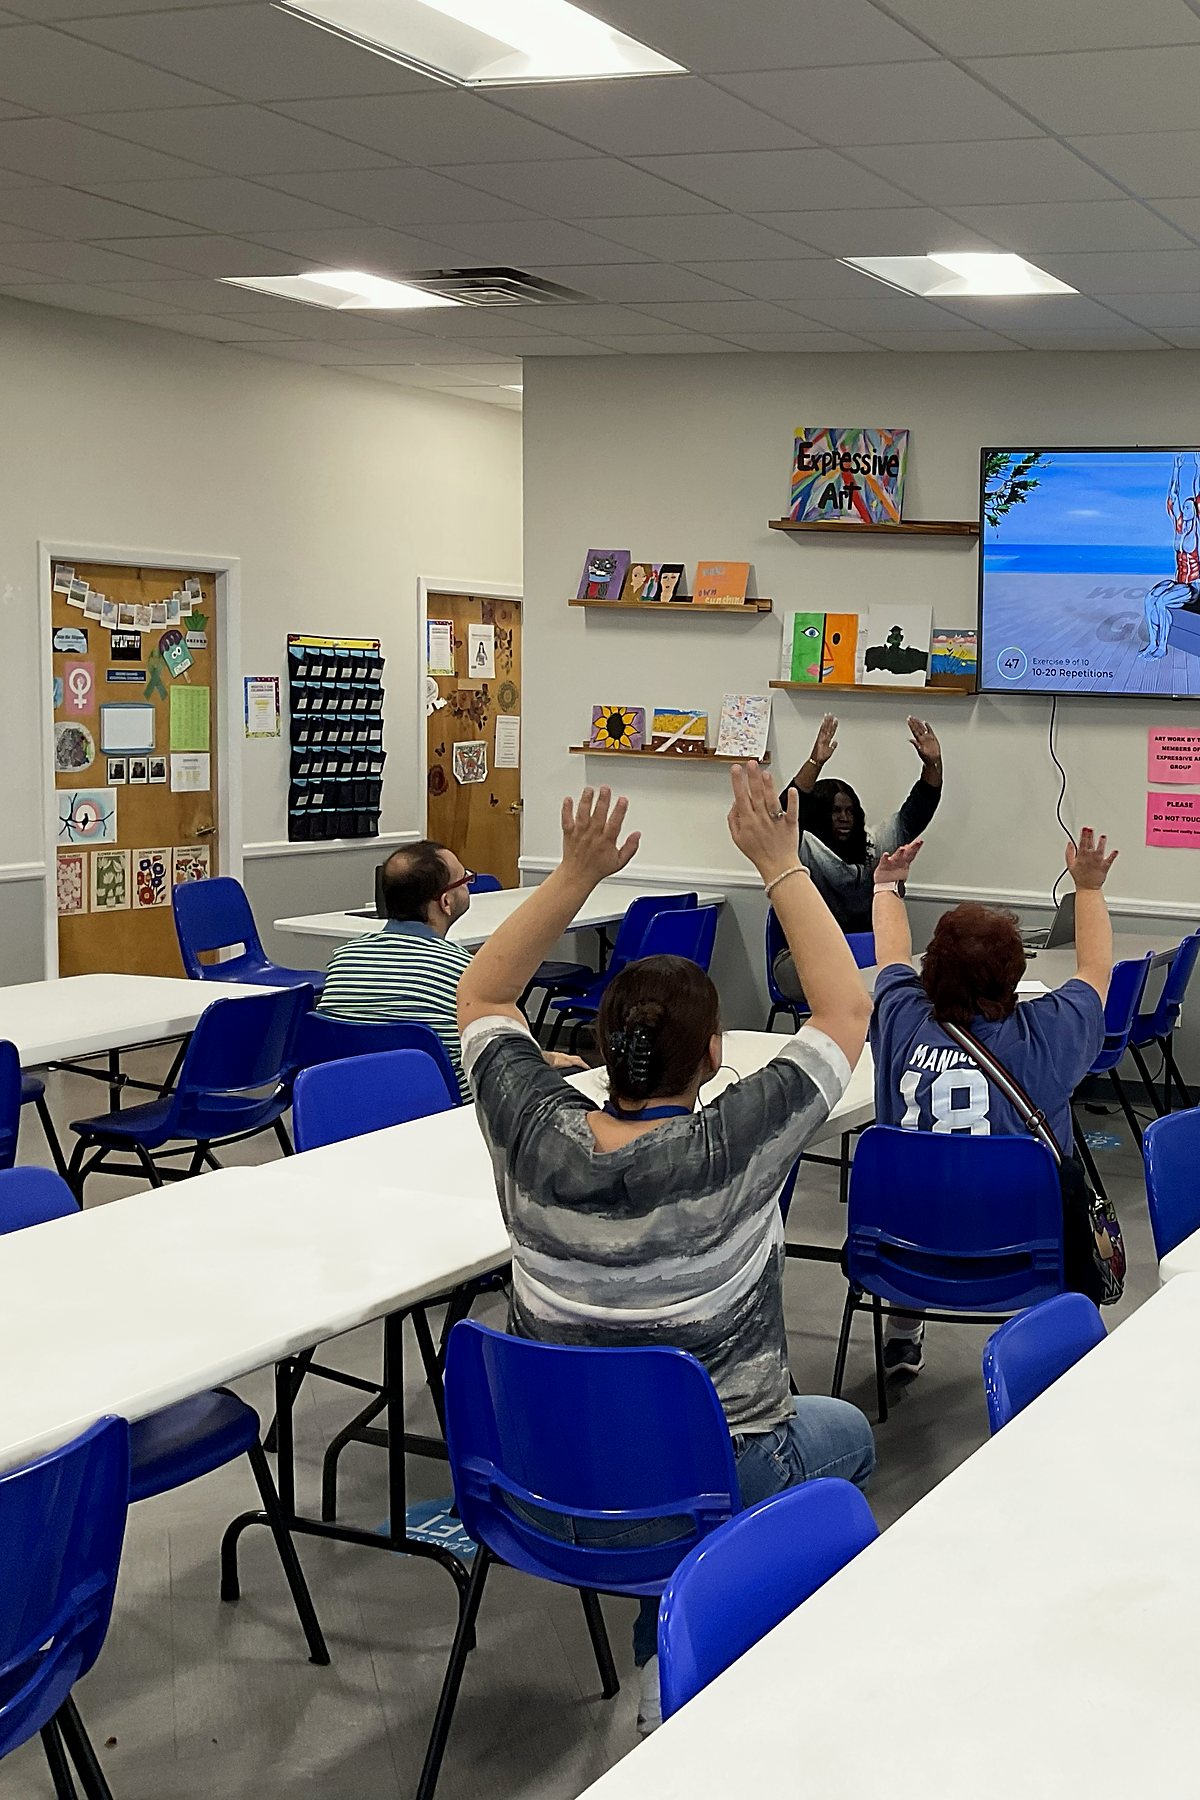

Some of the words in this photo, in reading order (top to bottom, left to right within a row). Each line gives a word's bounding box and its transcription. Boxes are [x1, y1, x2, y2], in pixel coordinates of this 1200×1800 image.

[797, 441, 899, 477] Expressive
[1004, 659, 1020, 669] 47
[1032, 668, 1057, 676] 10-20
[1059, 668, 1113, 679] Repetitions
[899, 1068, 990, 1136] 18
